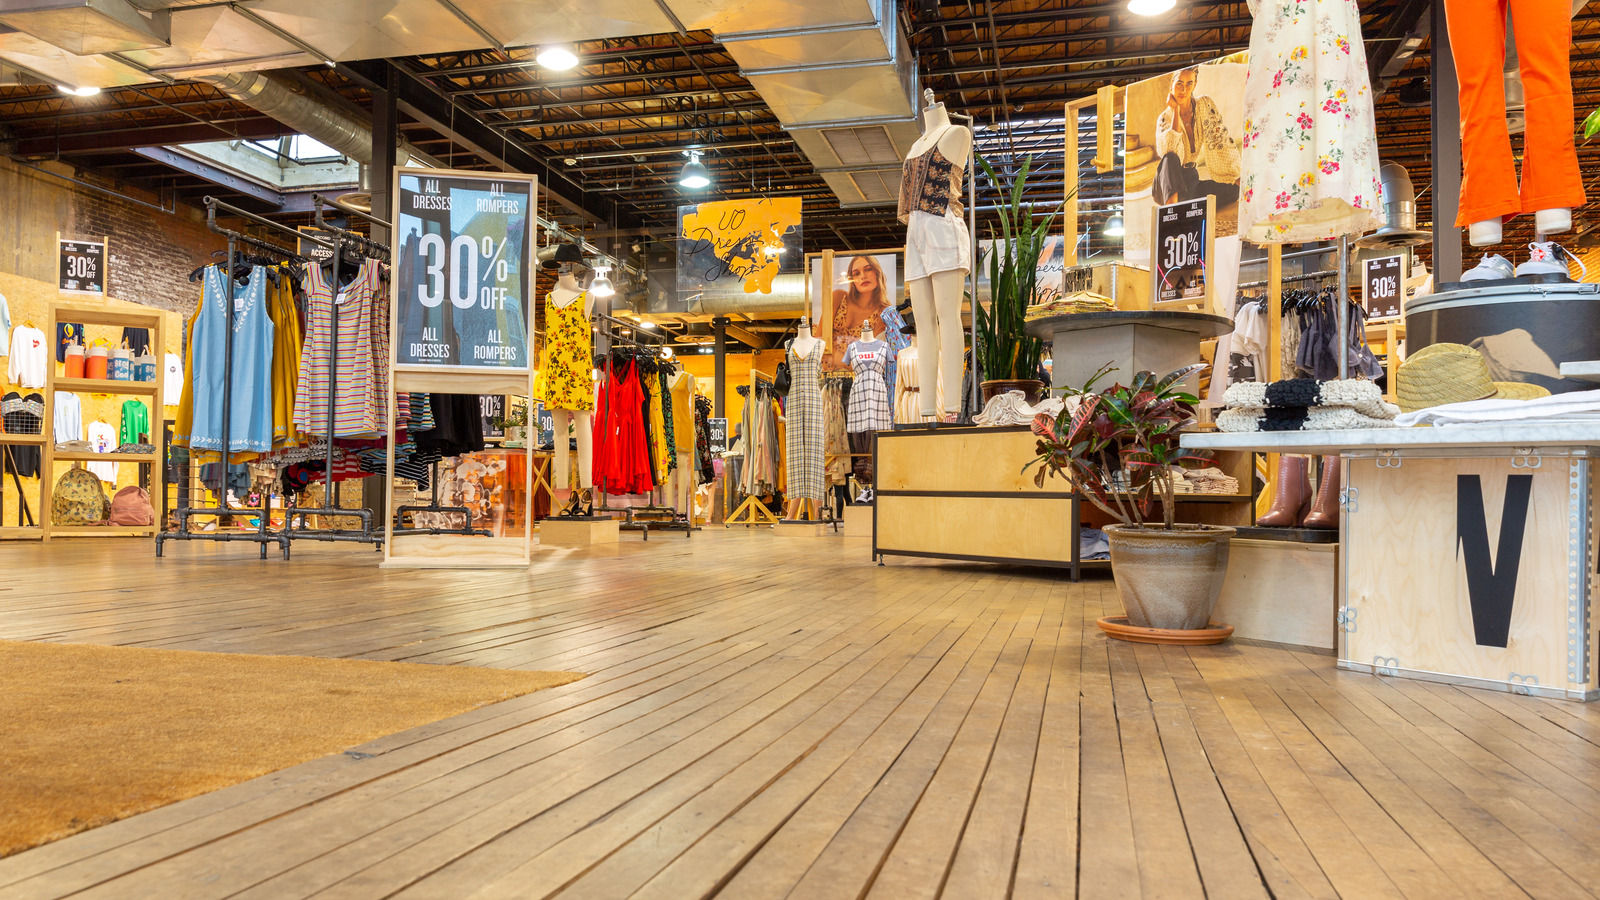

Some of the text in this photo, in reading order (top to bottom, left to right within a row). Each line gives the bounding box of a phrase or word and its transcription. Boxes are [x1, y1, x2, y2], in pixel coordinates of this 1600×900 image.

[425, 180, 441, 194] ALL
[490, 183, 505, 197] ALL
[413, 195, 452, 211] DRESSES
[476, 199, 519, 214] ROMPERS
[1186, 208, 1203, 218] ROMPERS
[1164, 231, 1199, 269] 30%
[67, 255, 96, 278] 30%
[1187, 254, 1198, 266] OFF
[418, 233, 508, 309] 30%
[1371, 275, 1396, 299] 30%
[1388, 289, 1396, 297] OFF
[480, 286, 508, 310] OFF
[422, 327, 438, 341] ALL
[487, 329, 503, 344] ALL
[410, 343, 450, 358] DRESSES
[474, 345, 517, 360] ROMPERS
[479, 395, 501, 417] 30%
[541, 416, 554, 431] 30
